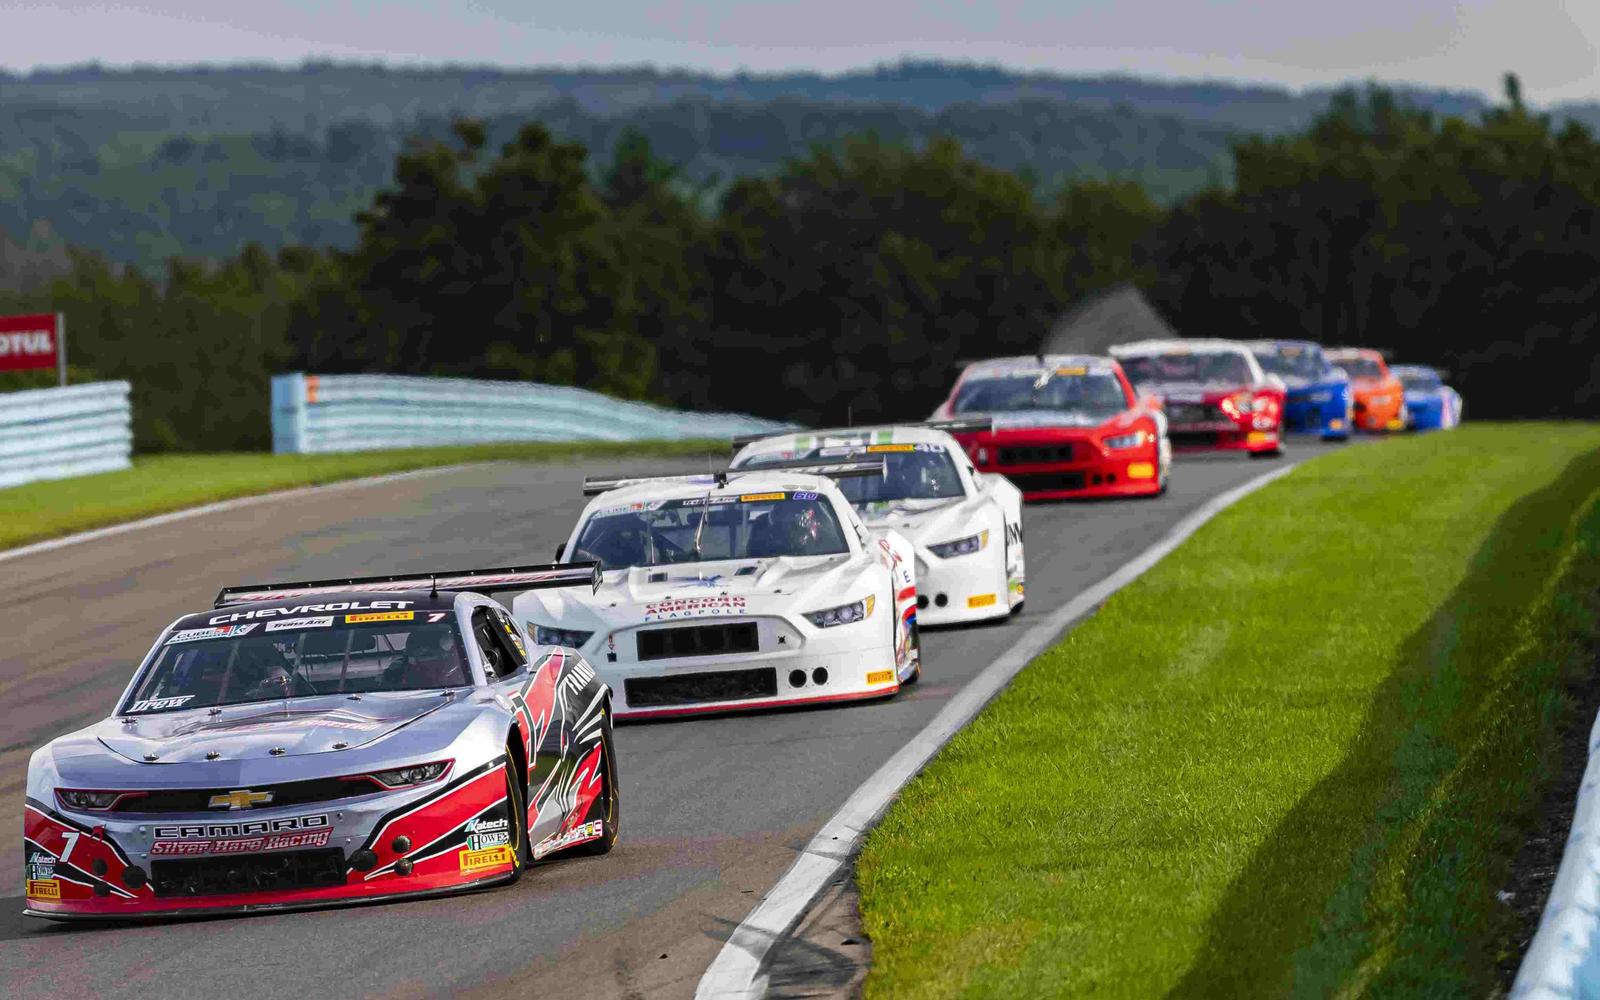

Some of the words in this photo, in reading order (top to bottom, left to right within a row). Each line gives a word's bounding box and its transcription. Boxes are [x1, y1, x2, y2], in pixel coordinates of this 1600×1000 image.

[645, 595, 745, 608] CONCORD
[645, 602, 746, 615] AMERICAN
[209, 600, 414, 625] CHEVROLET
[428, 612, 446, 623] 7
[644, 608, 745, 622] FLAGPOLE
[153, 813, 329, 840] CAMARO
[464, 818, 508, 833] Katech
[60, 831, 80, 863] 7
[151, 839, 212, 855] Silver
[210, 837, 266, 853] Hare
[263, 828, 334, 851] Racing
[463, 847, 506, 867] PIRELLI
[29, 880, 59, 897] PIRELLI
